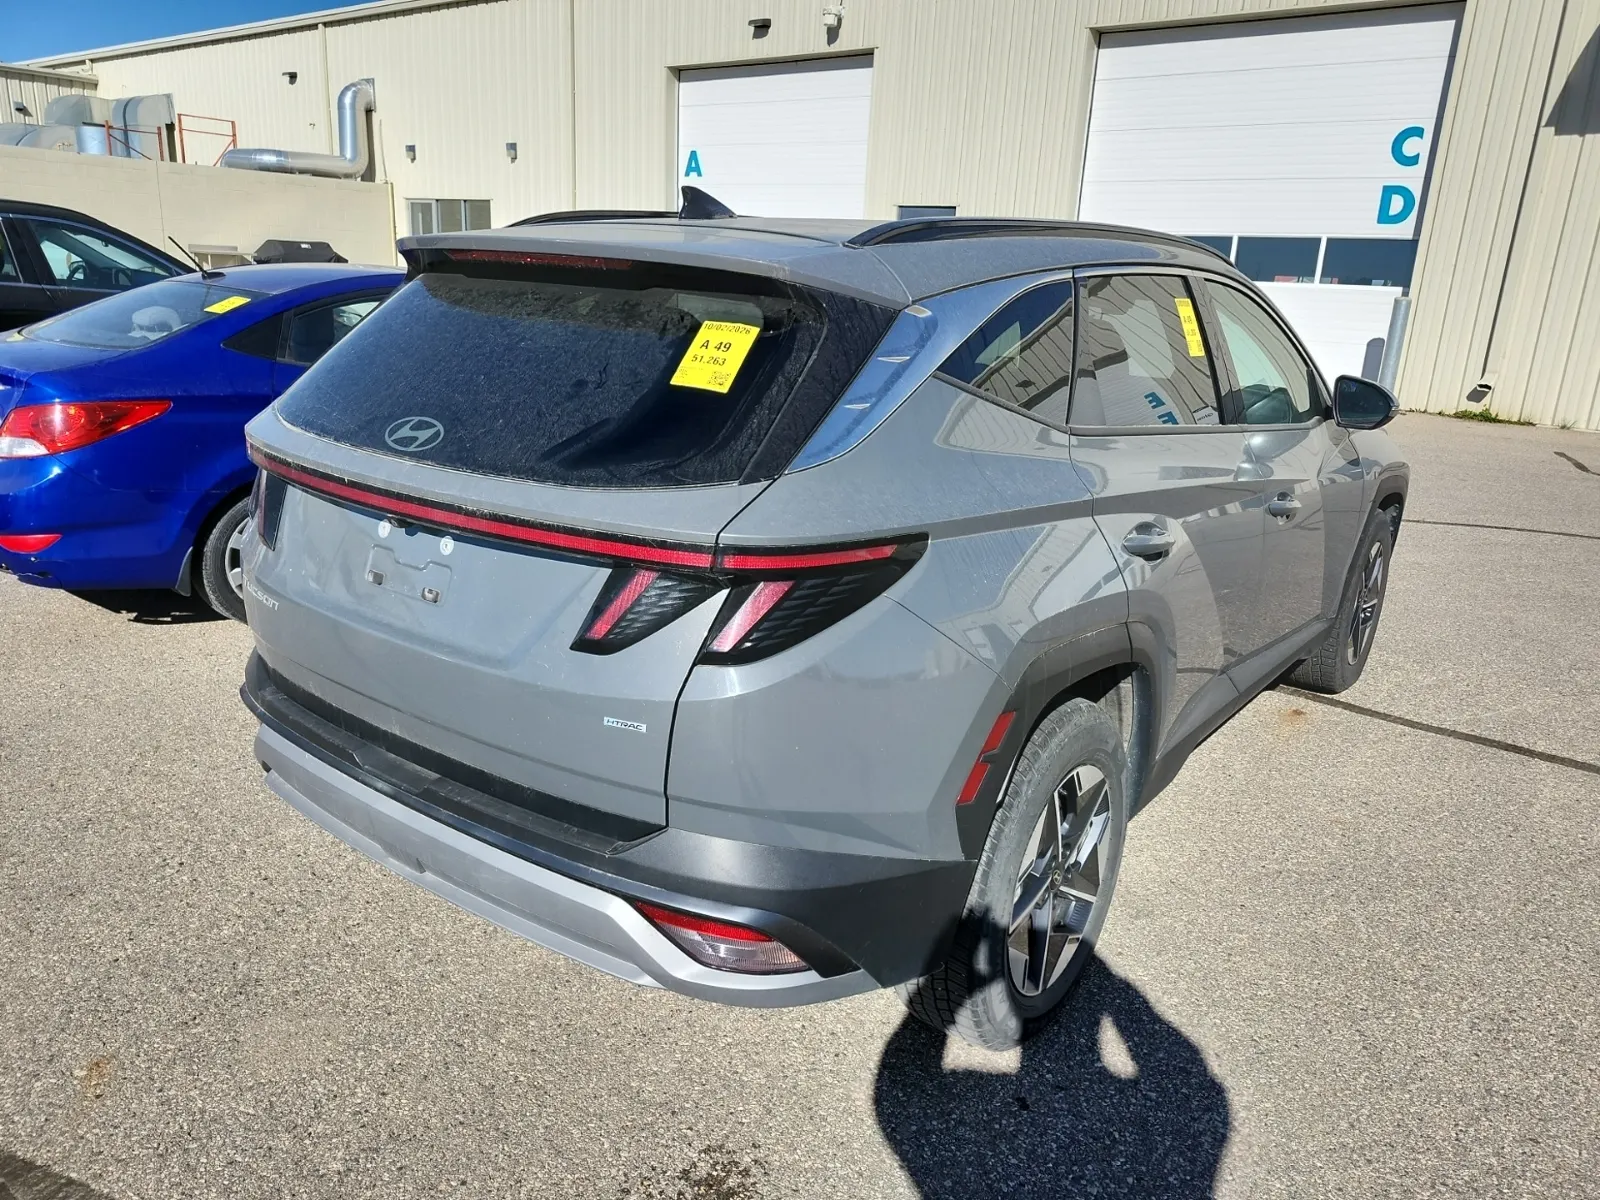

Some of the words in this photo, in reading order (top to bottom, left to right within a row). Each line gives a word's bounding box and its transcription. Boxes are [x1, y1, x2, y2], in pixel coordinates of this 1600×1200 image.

[1391, 126, 1425, 167] C
[684, 150, 703, 177] A
[1377, 185, 1416, 224] D
[703, 323, 752, 335] 10/02/2026
[700, 340, 710, 350] A
[714, 341, 732, 352] 49
[691, 354, 727, 366] 51.263
[606, 718, 643, 731] HTRAC
